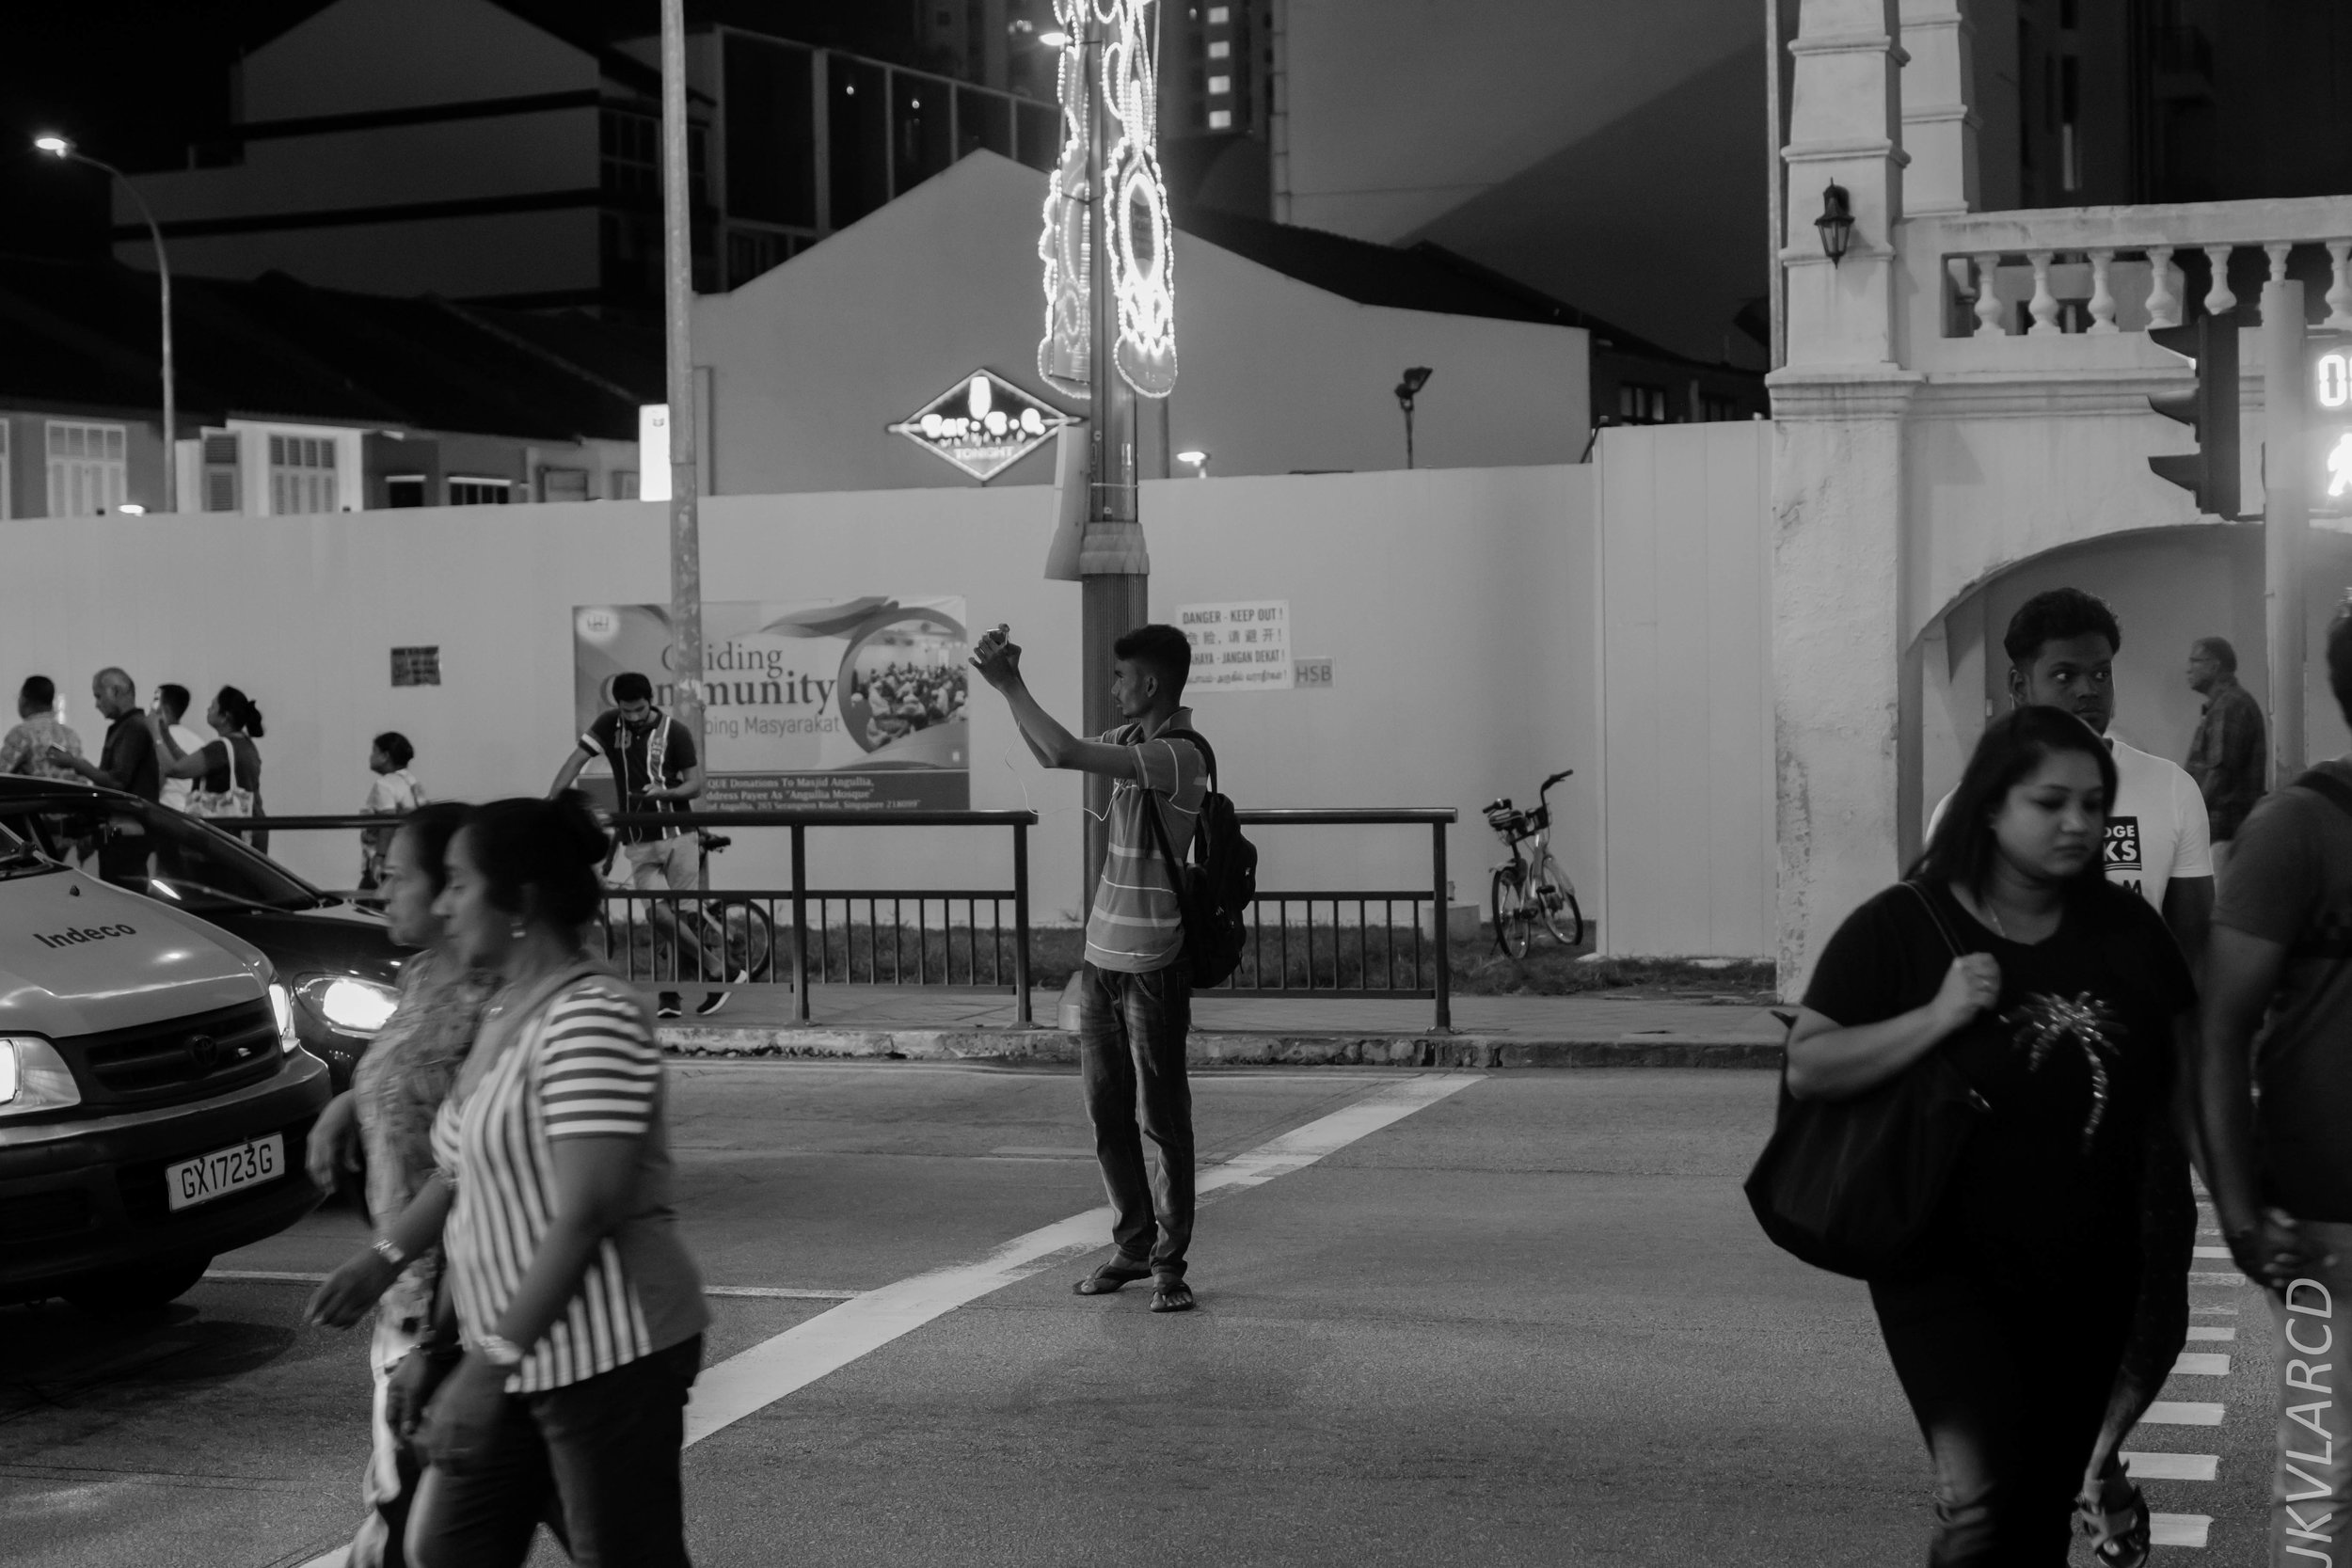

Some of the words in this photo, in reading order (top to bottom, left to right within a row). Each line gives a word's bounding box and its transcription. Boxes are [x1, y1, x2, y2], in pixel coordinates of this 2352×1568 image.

[2318, 354, 2352, 406] 0
[1183, 611, 1221, 625] DANGER
[1231, 610, 1254, 623] KEEP
[661, 641, 784, 678] iding
[1190, 653, 1215, 665] AHAYA
[1222, 651, 1253, 663] JANGAN
[1295, 666, 1332, 682] HSB
[600, 671, 836, 715] Cmmunity
[744, 716, 840, 737] Masyarakat
[730, 778, 778, 787] Donations
[781, 777, 794, 786] To
[797, 776, 828, 787] Masjid
[706, 791, 738, 800] ddress
[2104, 840, 2137, 862] KS
[33, 922, 137, 949] Indeco
[181, 1143, 273, 1199] GX1723G
